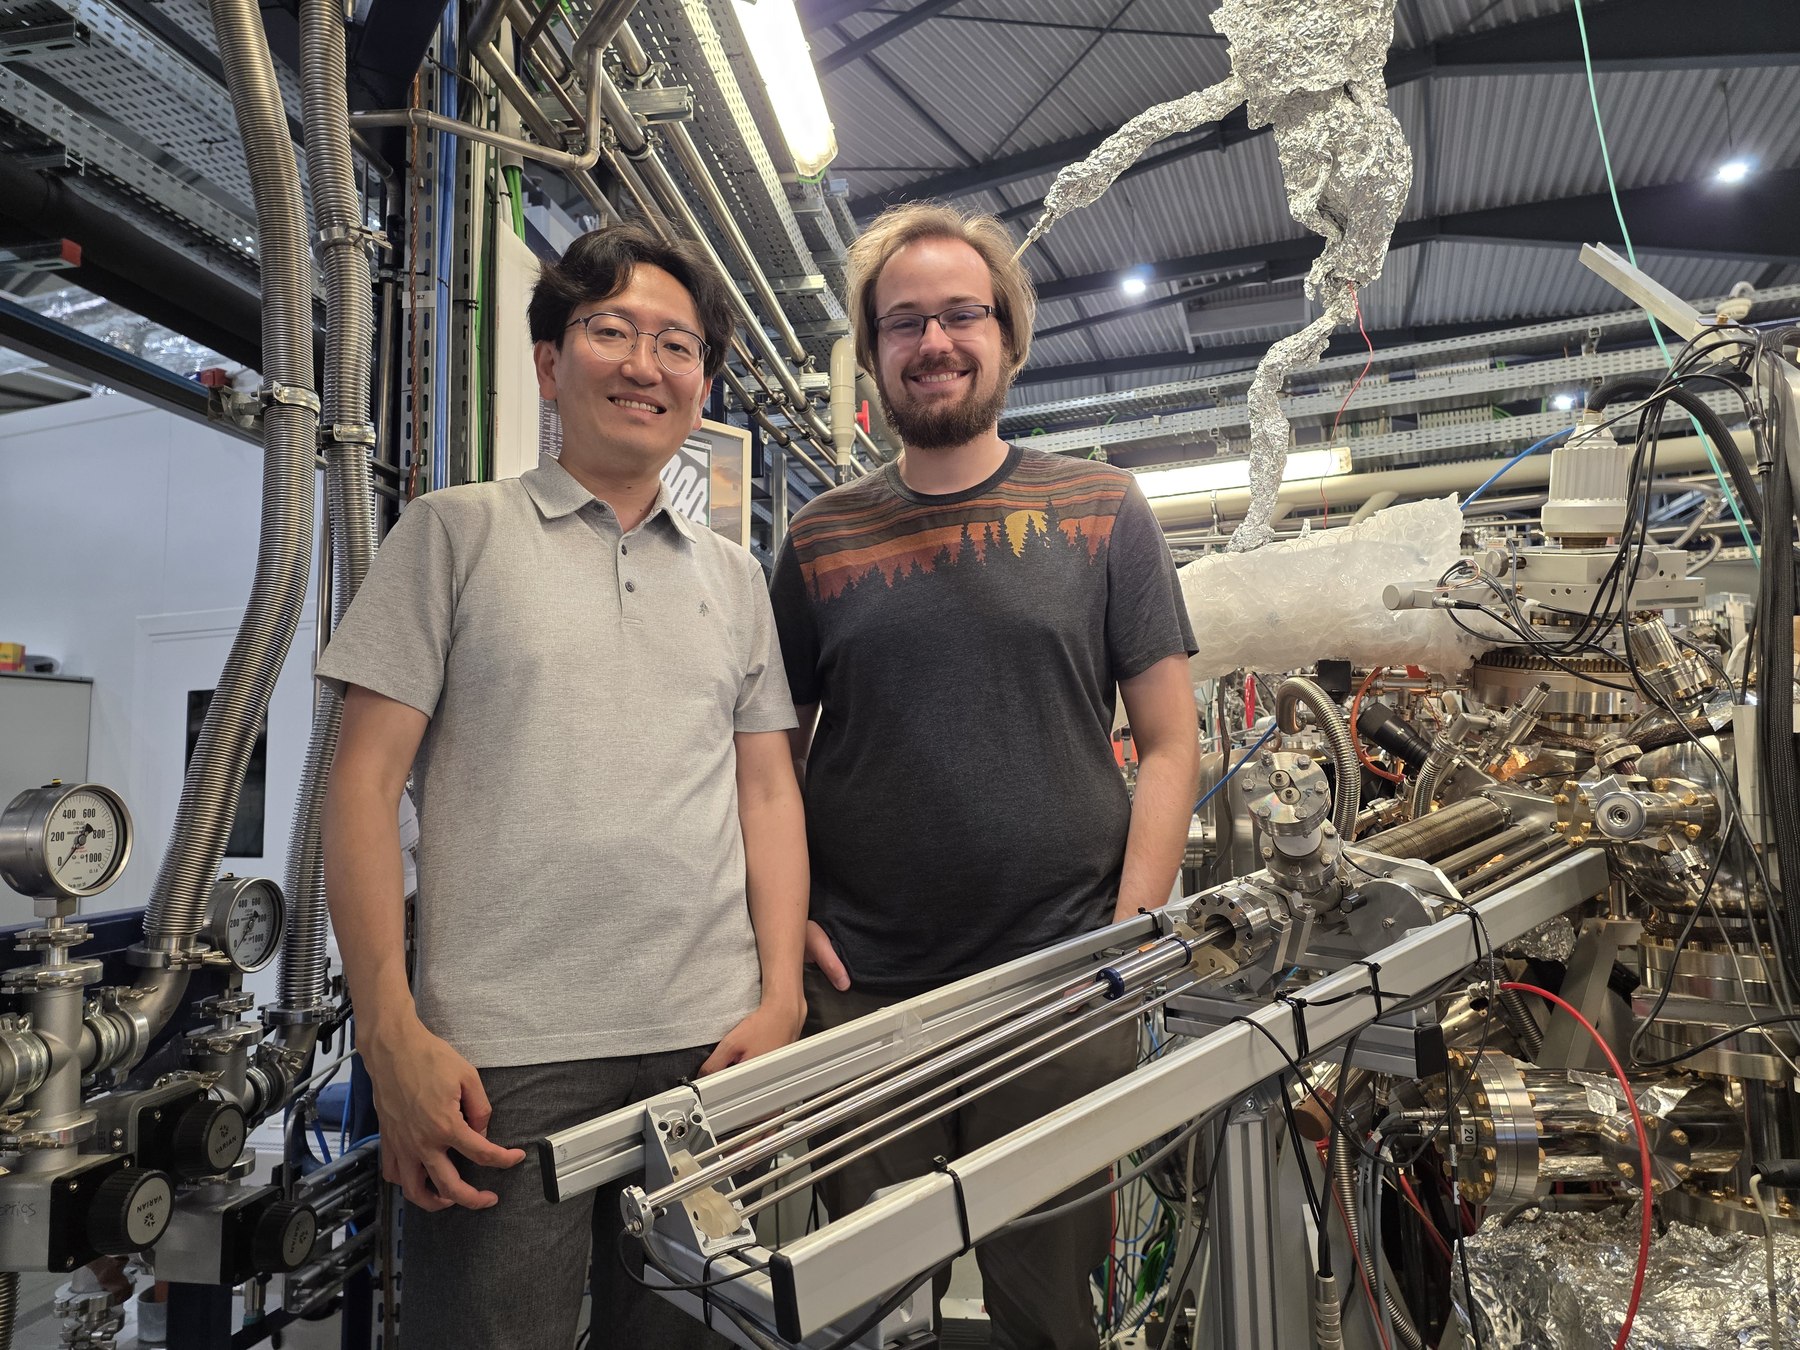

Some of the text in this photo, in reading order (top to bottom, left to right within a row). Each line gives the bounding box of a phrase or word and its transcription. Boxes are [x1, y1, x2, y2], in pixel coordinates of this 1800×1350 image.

[62, 808, 96, 819] 400 600
[51, 832, 65, 842] 200
[92, 829, 106, 839] 800
[57, 853, 102, 867] 0 1000
[238, 897, 261, 908] 400 600
[230, 918, 239, 928] 200
[252, 933, 264, 944] 1000
[1464, 1128, 1474, 1143] 20
[215, 1135, 237, 1154] VARIAN
[136, 1195, 163, 1213] VARIAN
[290, 1221, 301, 1253] VARIAN
